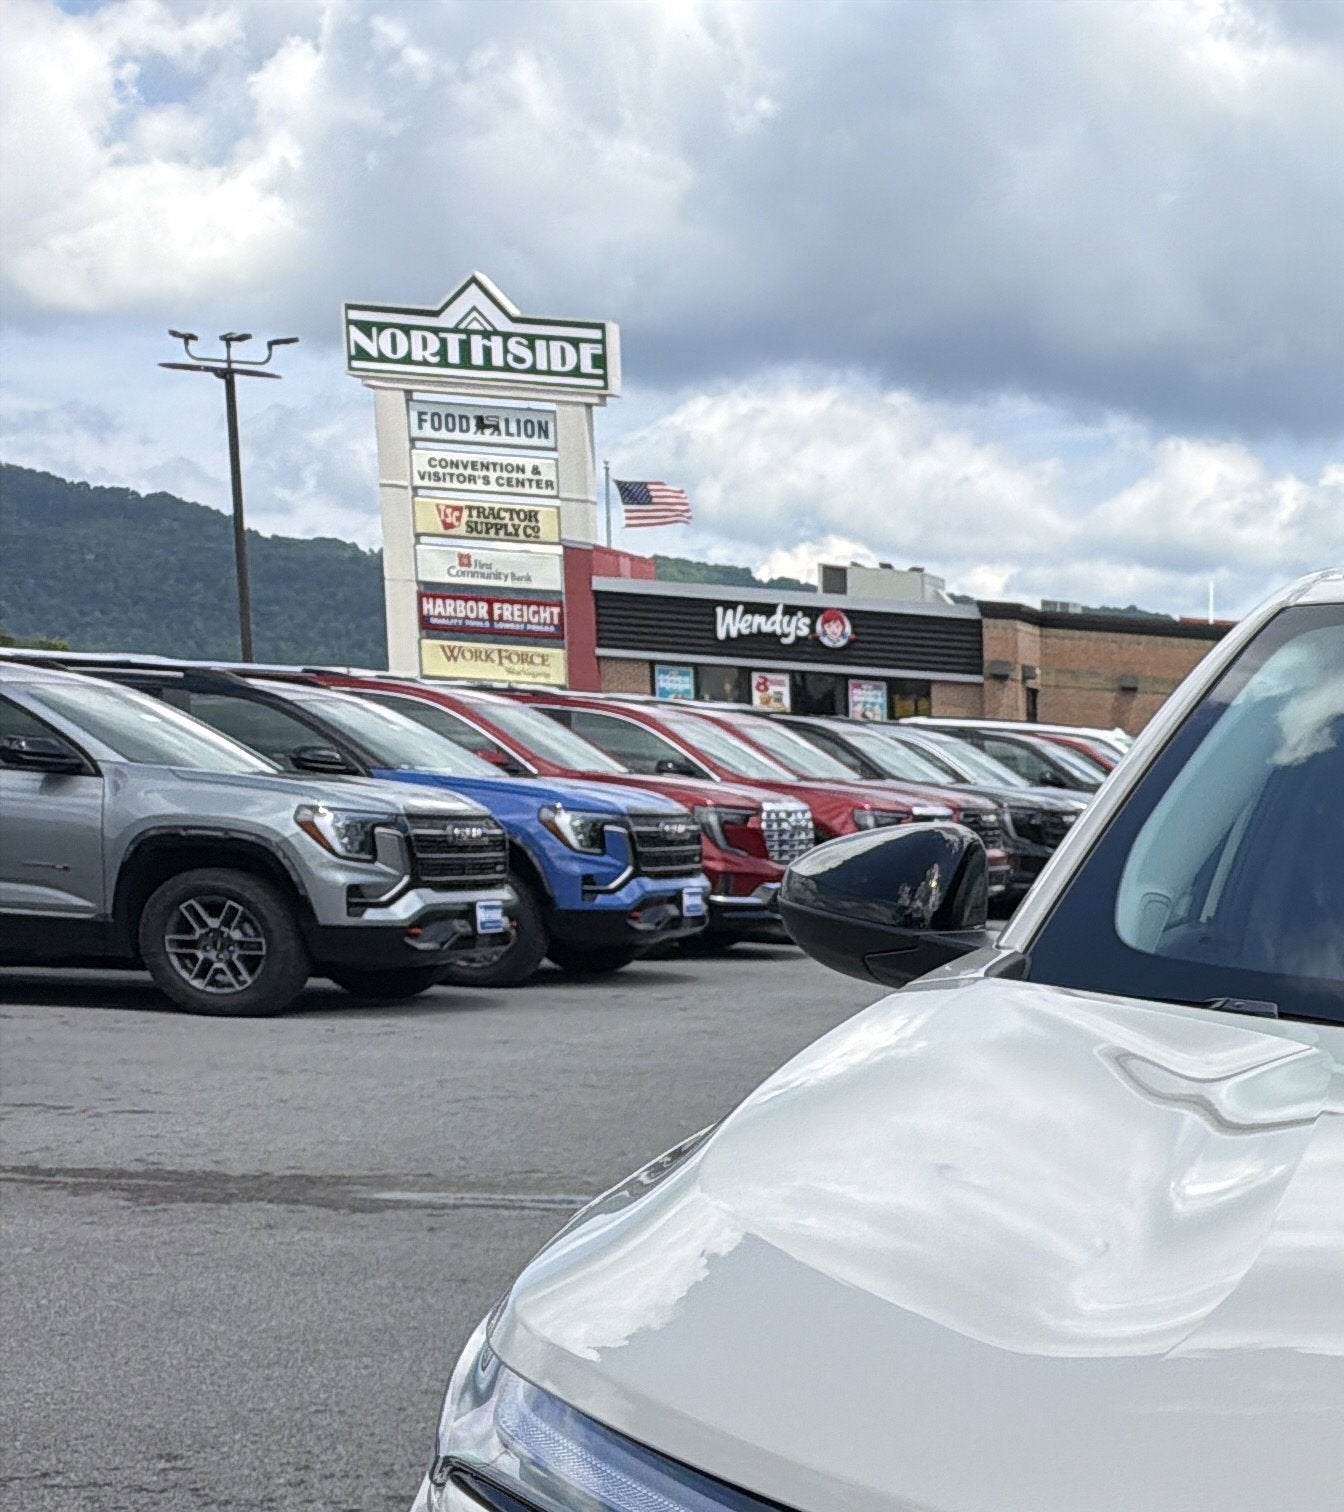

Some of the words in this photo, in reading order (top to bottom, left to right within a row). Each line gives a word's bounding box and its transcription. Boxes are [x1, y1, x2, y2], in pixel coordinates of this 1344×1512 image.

[349, 324, 605, 375] NORTHSIDE
[417, 411, 471, 434] FOOD
[504, 417, 550, 440] LION
[428, 457, 526, 475] CONVENTION
[531, 464, 542, 476] &
[417, 470, 491, 486] VISITOR'S
[496, 476, 555, 491] CENTER
[465, 504, 541, 524] TRACTOR
[465, 520, 520, 537] SUPPLY
[447, 565, 509, 583] Community
[422, 597, 489, 620] HARBOR
[493, 602, 561, 625] FREIGHT
[715, 602, 812, 645] Wendy's
